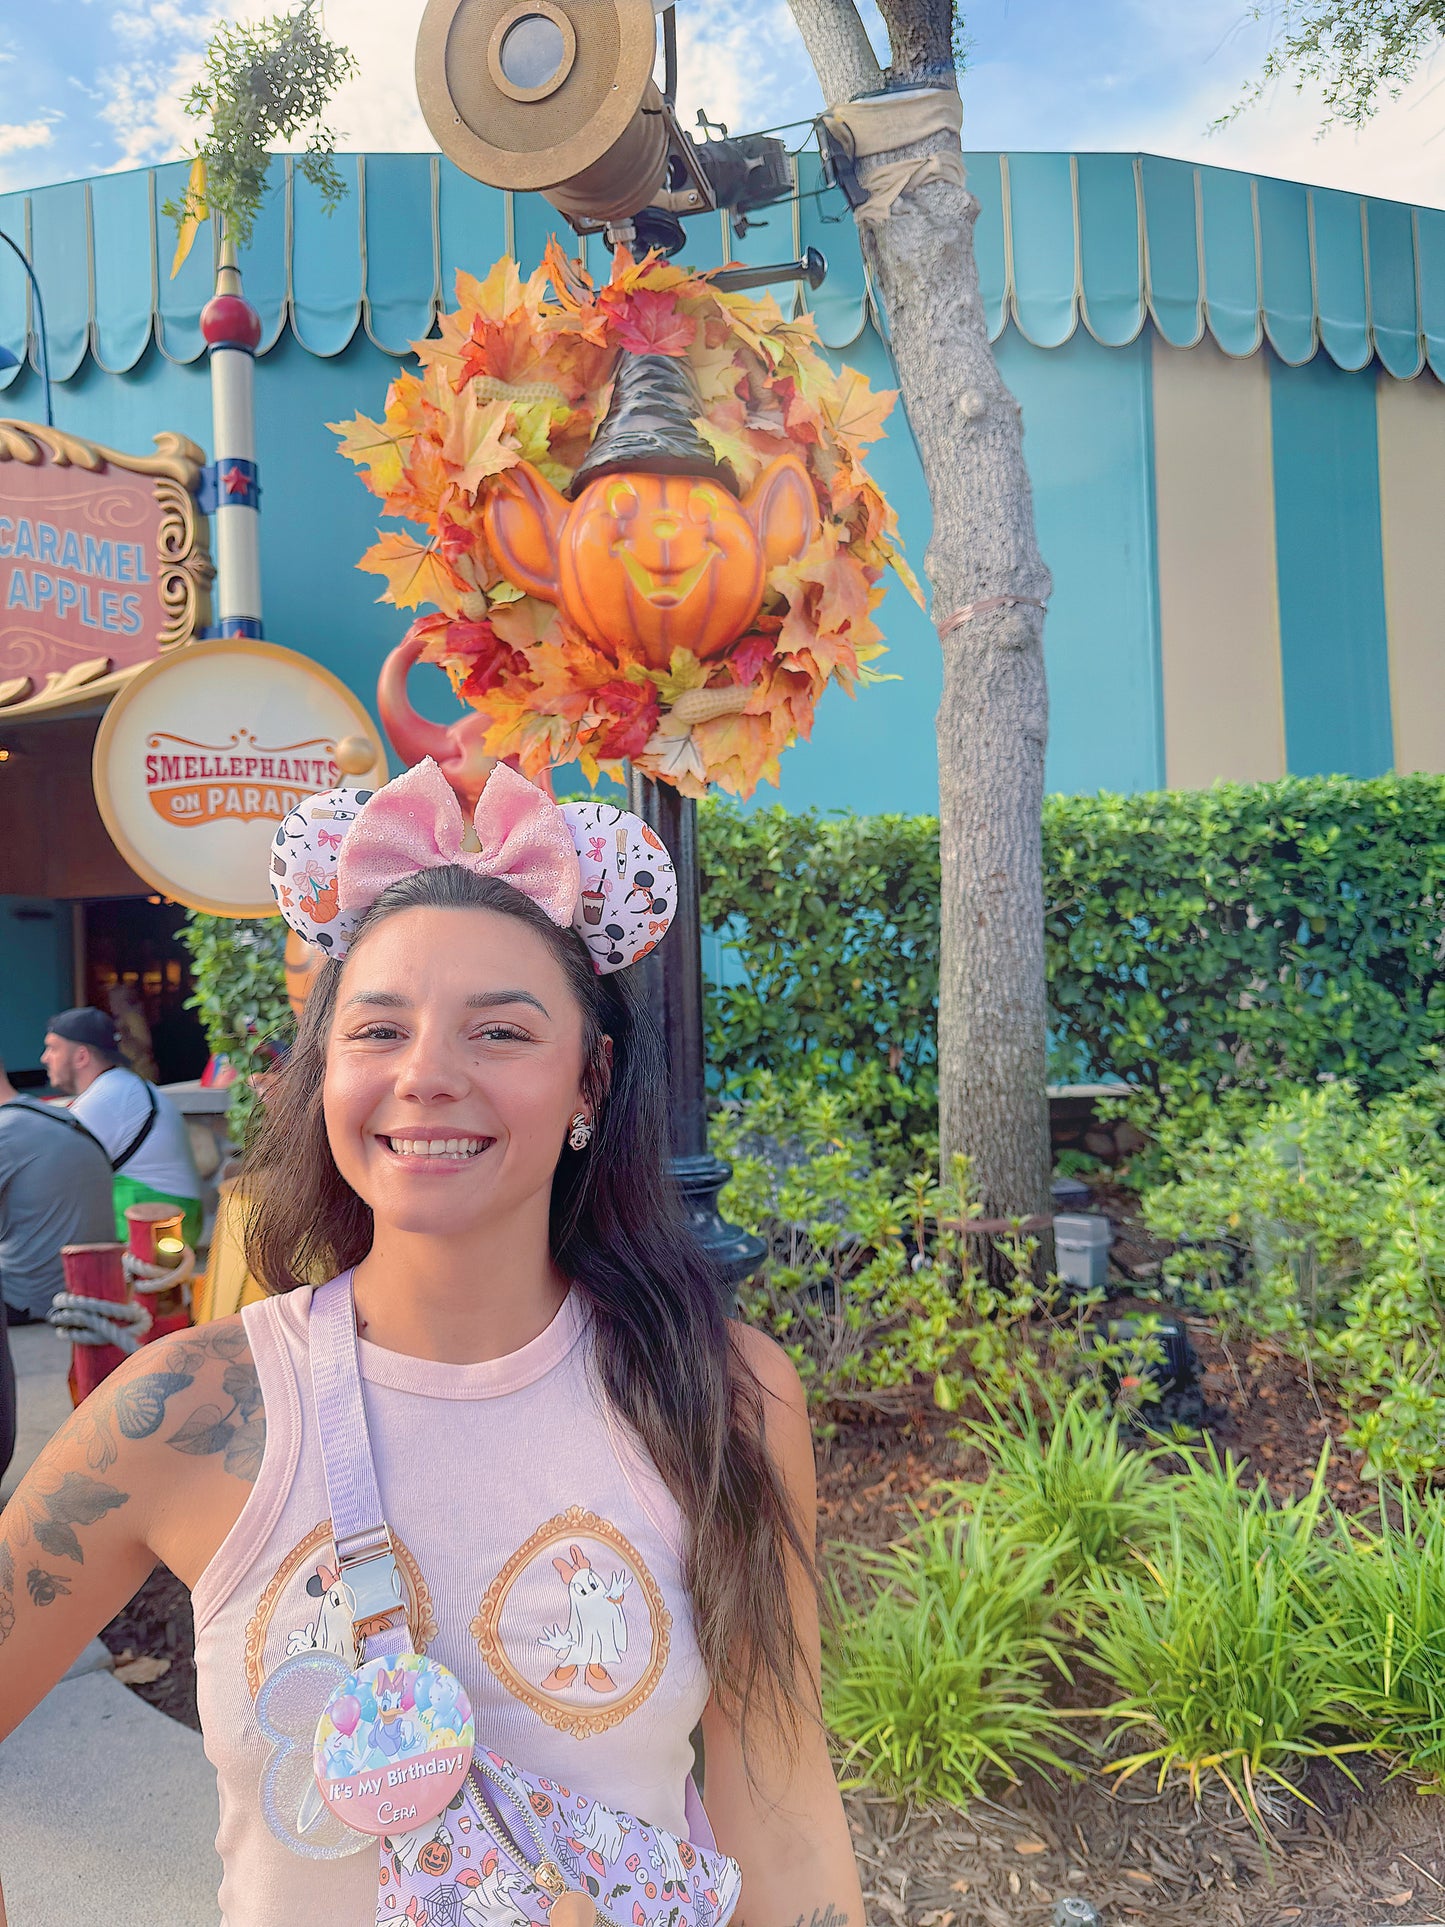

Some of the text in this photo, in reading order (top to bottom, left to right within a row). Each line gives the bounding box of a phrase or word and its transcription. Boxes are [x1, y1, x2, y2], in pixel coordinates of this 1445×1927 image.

[0, 516, 151, 584] CARAMEL
[7, 568, 143, 636] APPLES
[146, 754, 341, 787] SMELLEPHANTS
[170, 788, 309, 816] ON PARAD
[329, 1753, 464, 1801] It's My Birthday!
